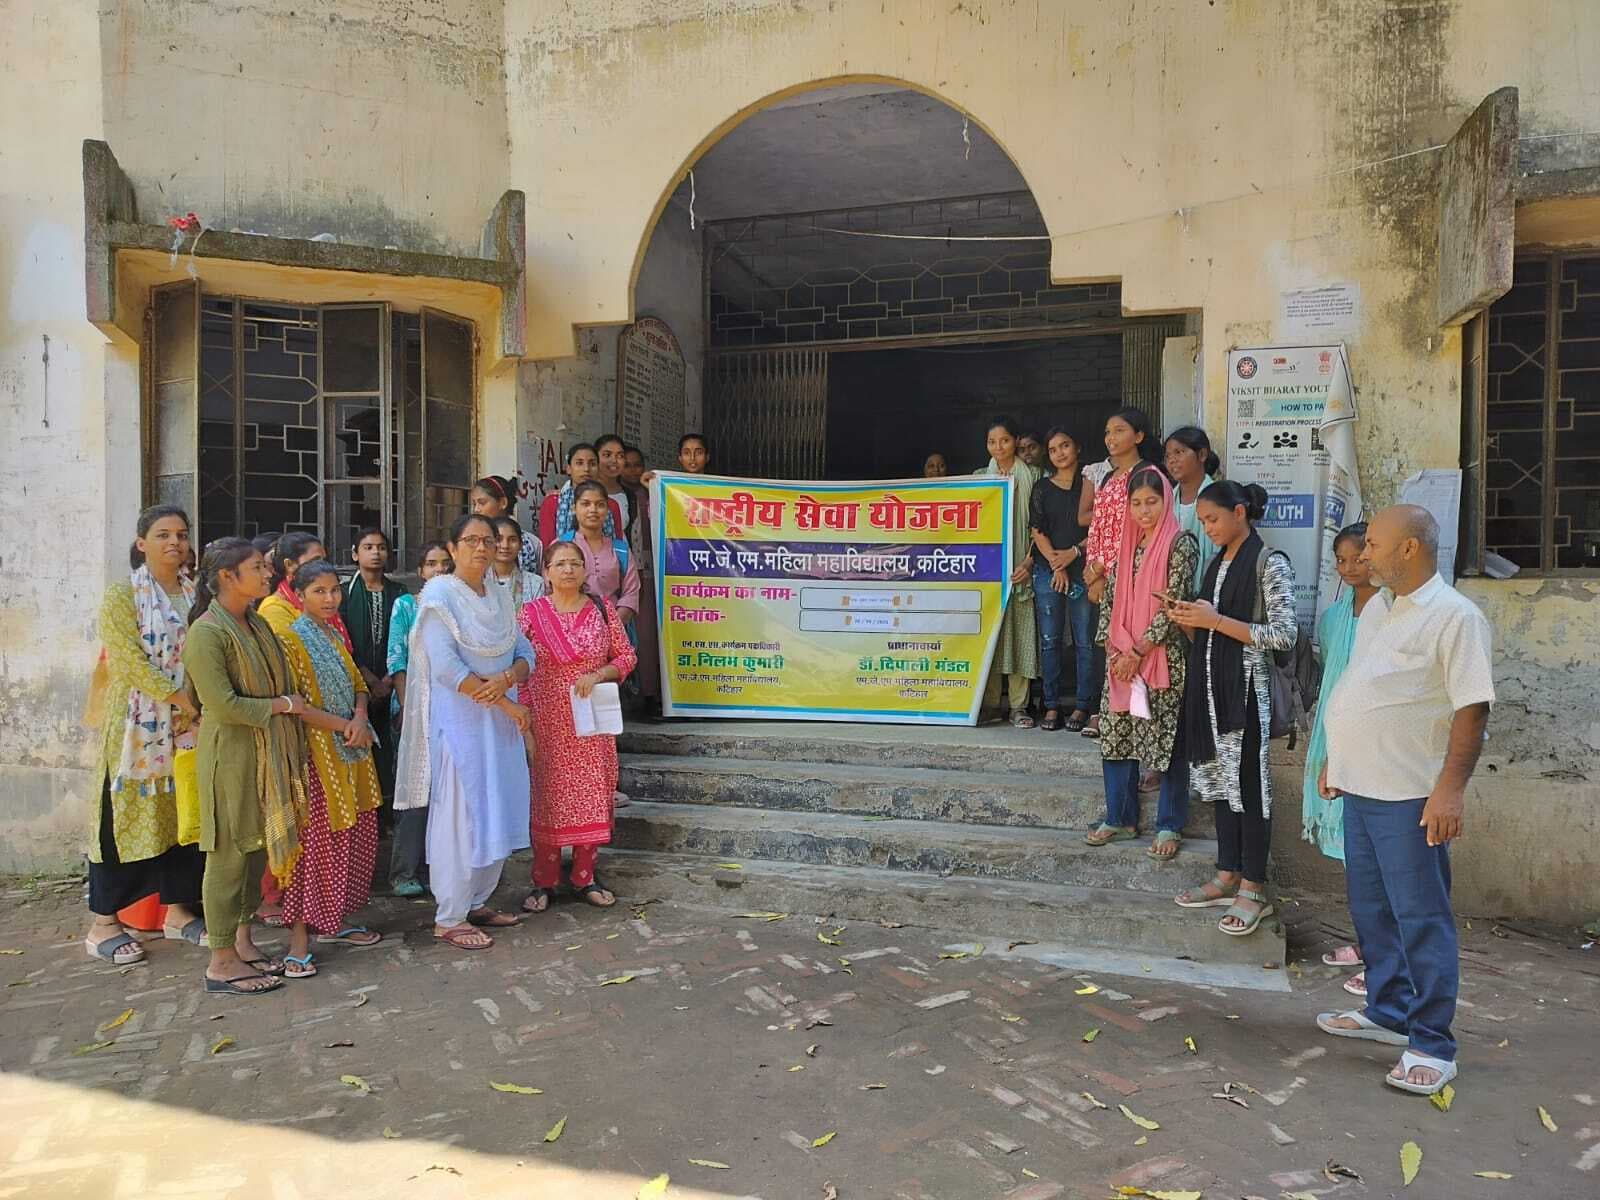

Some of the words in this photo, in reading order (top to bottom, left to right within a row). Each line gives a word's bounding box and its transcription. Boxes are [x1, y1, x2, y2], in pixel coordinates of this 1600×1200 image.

[1231, 386, 1260, 395] VIKSIT
[1263, 385, 1300, 394] BHARAT
[687, 492, 786, 536] राष्ट्रीय
[795, 495, 861, 531] सेवा
[868, 496, 982, 531] योजना
[690, 545, 811, 573] एम.जे.एम.महिला
[671, 581, 731, 599] कार्यक्रम
[734, 586, 756, 600] का
[670, 604, 727, 622] दिनांक-
[742, 654, 784, 672] कुमारी
[934, 657, 970, 672] मंडल
